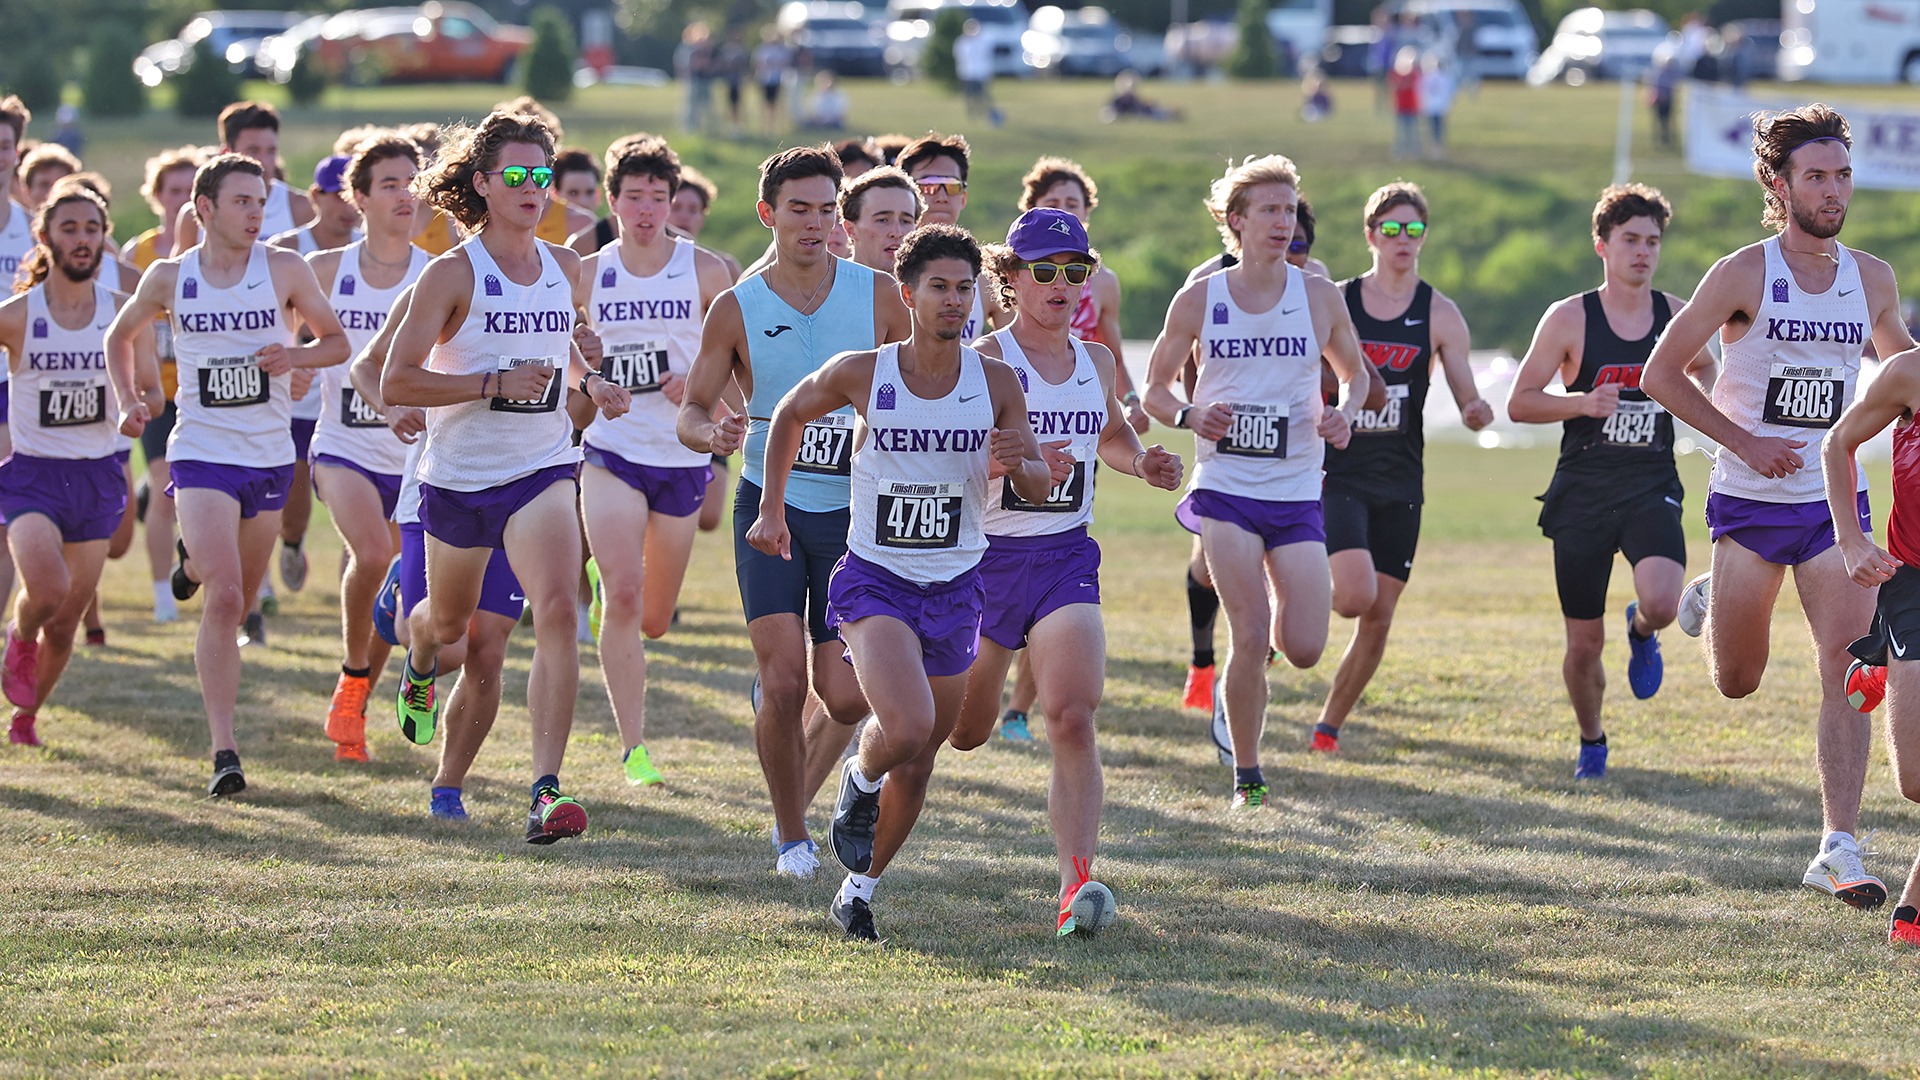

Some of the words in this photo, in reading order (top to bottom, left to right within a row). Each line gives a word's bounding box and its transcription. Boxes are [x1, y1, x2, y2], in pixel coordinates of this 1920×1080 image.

[179, 309, 276, 333] KENYON
[484, 311, 569, 334] KENYON
[598, 300, 691, 322] KENYON
[1766, 318, 1864, 345] KENYON
[1209, 337, 1307, 359] KENYON
[207, 366, 261, 400] 4809
[611, 352, 660, 387] 4791
[1782, 366, 1823, 378] FinishTiming
[47, 388, 98, 421] 4798
[1775, 380, 1834, 419] 4803
[873, 428, 988, 452] KENYON
[1225, 415, 1279, 449] 4805
[1602, 413, 1656, 443] 4834
[795, 427, 848, 465] 837
[890, 483, 937, 495] FinishTiming
[887, 498, 950, 538] 4795
